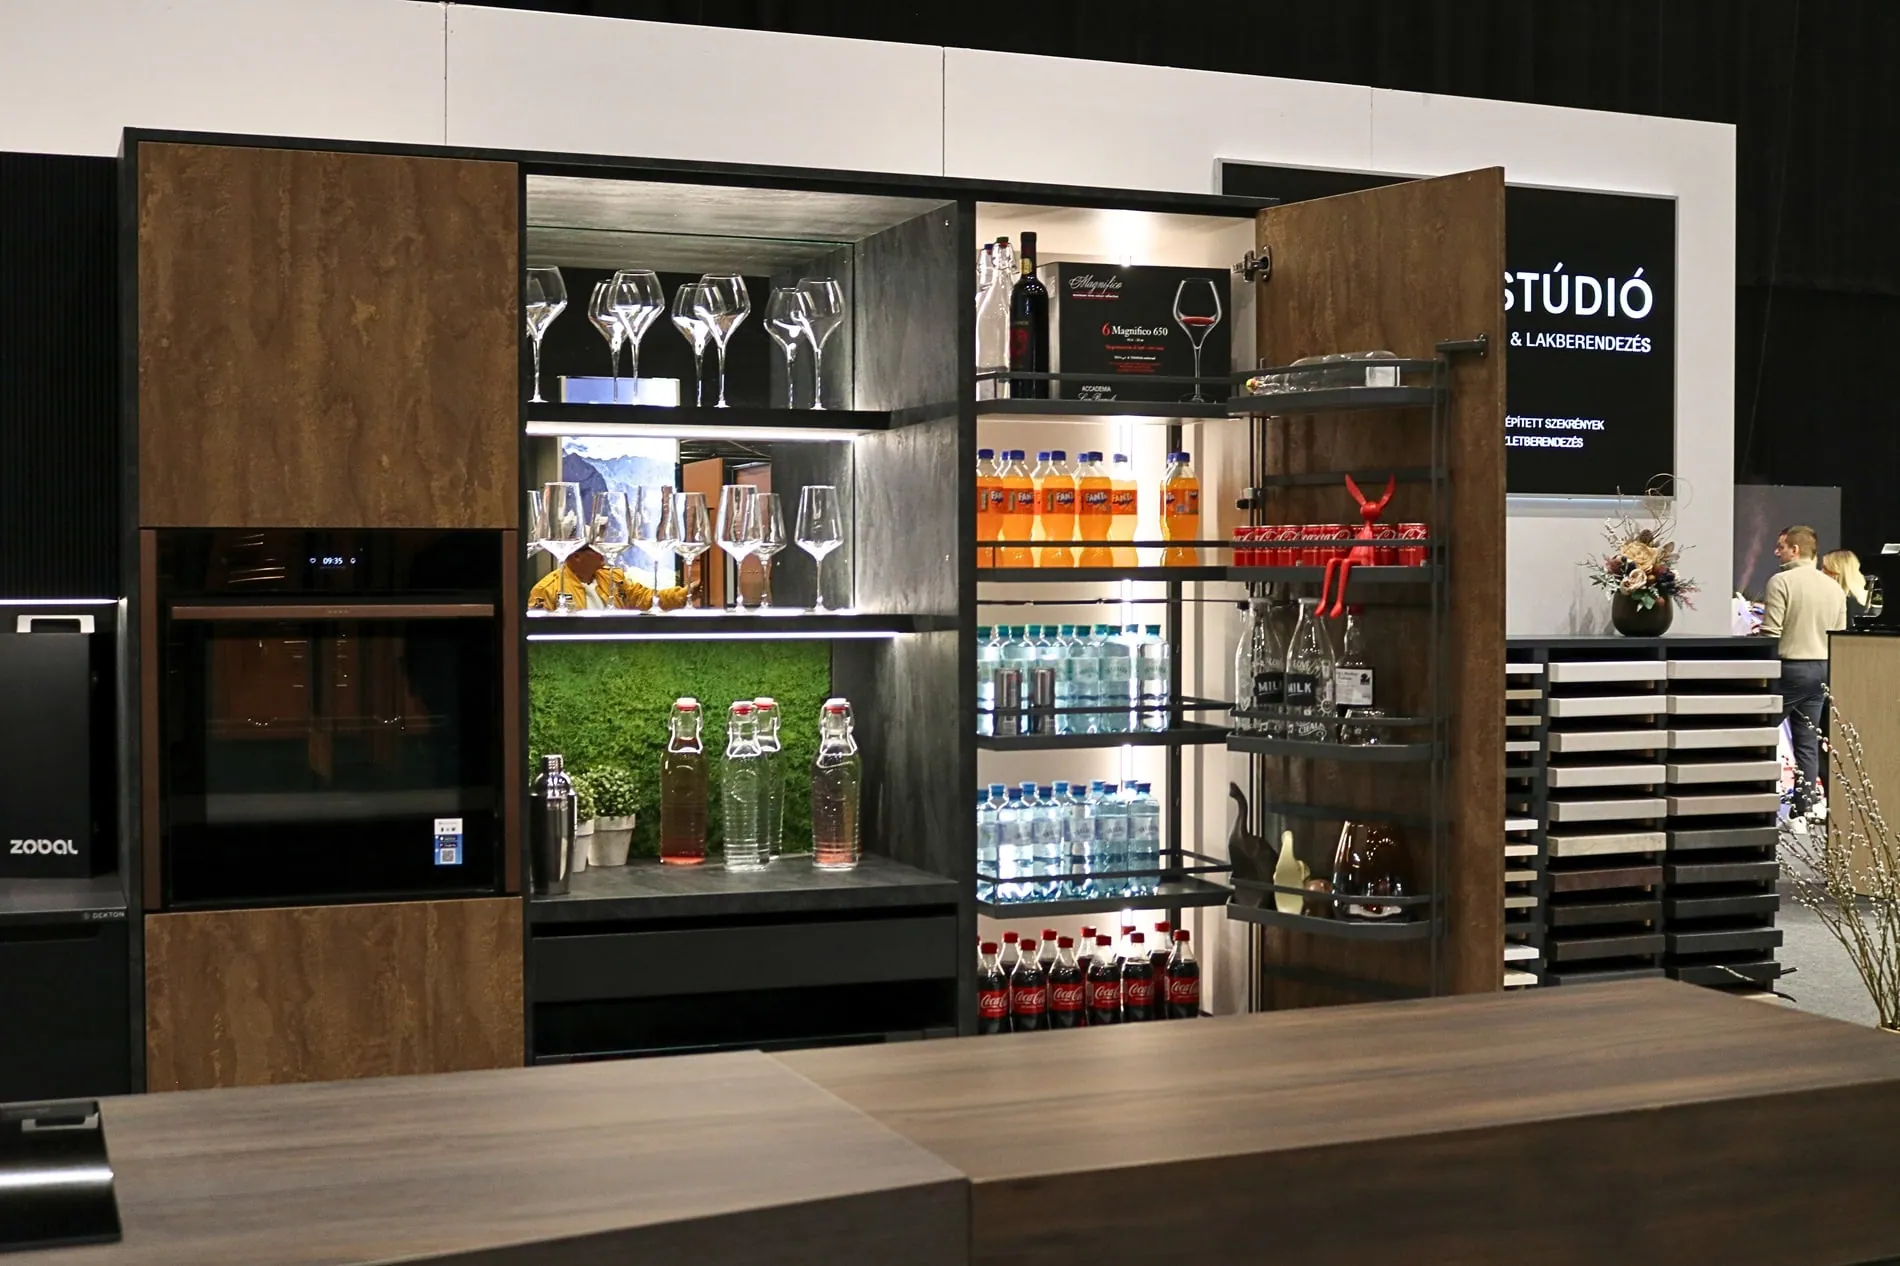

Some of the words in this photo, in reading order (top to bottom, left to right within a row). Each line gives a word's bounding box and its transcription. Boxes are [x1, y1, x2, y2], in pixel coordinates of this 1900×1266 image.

[1102, 323, 1111, 336] 6
[1111, 325, 1152, 337] Magnifico
[1153, 327, 1168, 336] 650
[1510, 331, 1522, 347] &
[1526, 332, 1652, 353] LAKBERENDEZÉS
[1545, 417, 1605, 430] SZEKRÉNYEK
[1258, 681, 1282, 693] MIL
